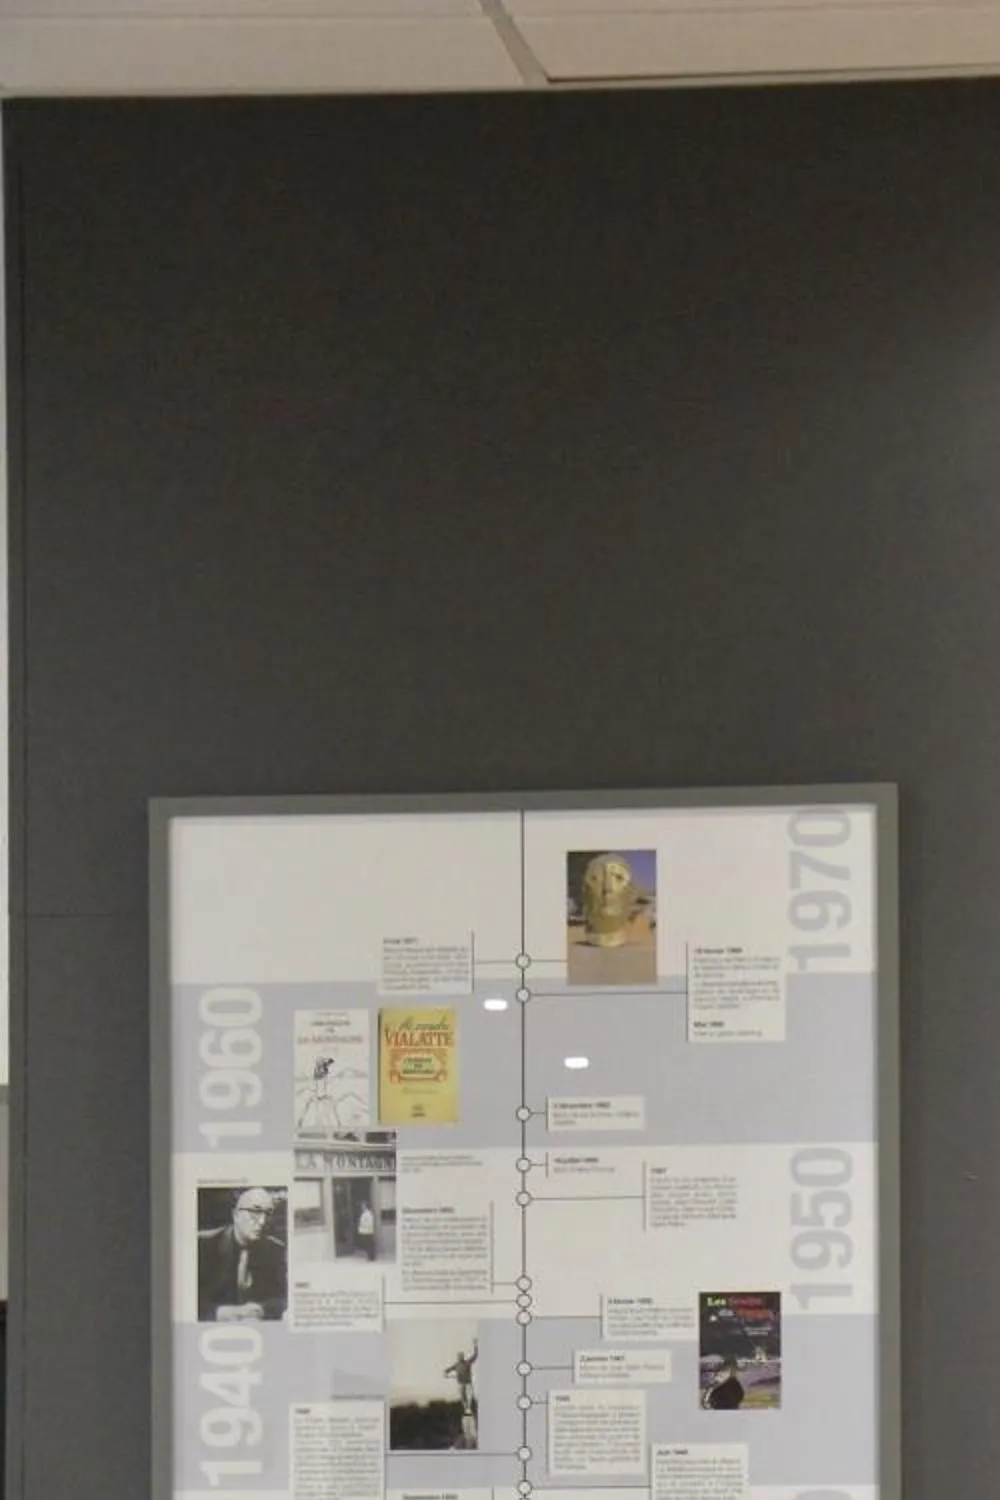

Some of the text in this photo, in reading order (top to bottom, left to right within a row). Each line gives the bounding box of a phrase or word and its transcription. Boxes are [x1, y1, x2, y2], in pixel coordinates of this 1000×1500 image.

[788, 808, 851, 973] 1970
[199, 987, 263, 1149] 1960
[385, 1028, 453, 1047] VIALATTE
[790, 1147, 854, 1310] 1950
[200, 1326, 264, 1486] 1940
